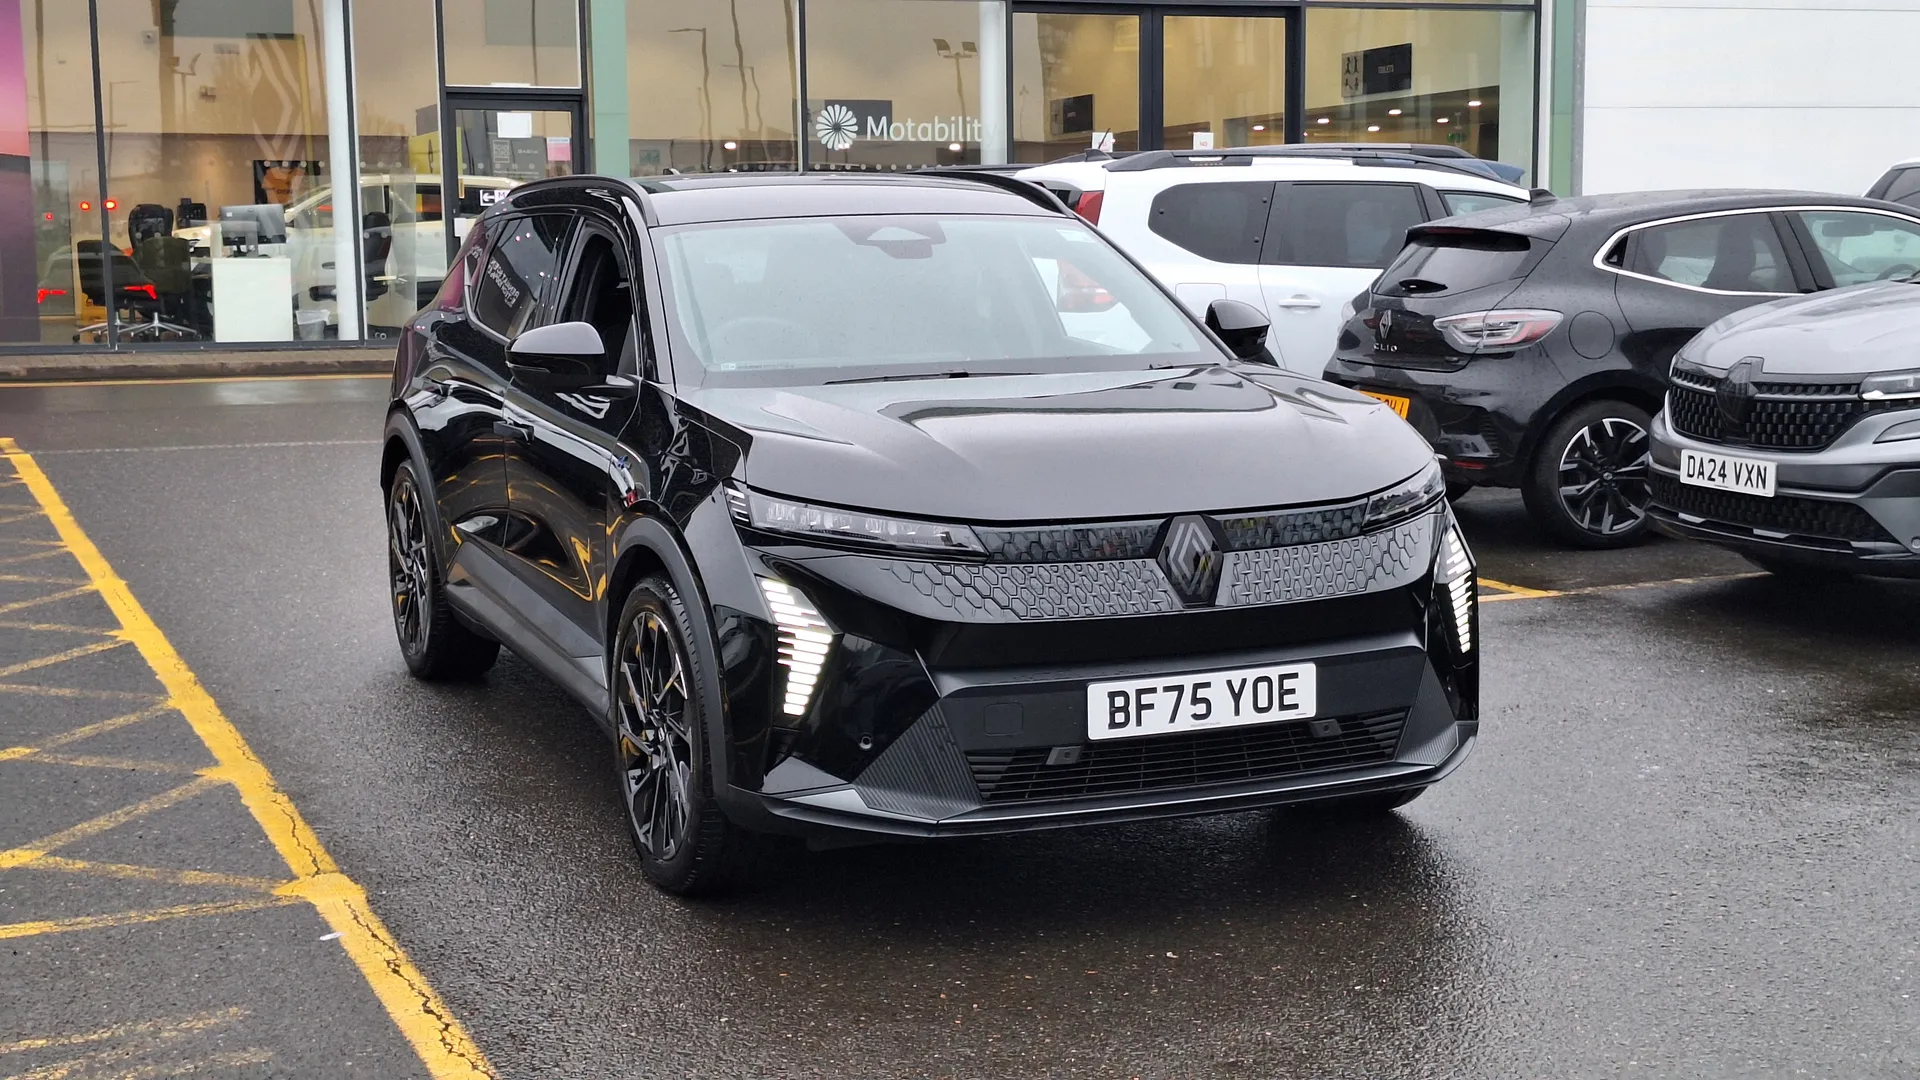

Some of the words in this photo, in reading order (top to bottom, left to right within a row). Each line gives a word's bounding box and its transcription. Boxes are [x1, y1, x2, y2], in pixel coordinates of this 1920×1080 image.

[1373, 342, 1398, 352] CLIO
[1687, 455, 1727, 483] DA24
[1733, 461, 1767, 489] VXN
[1107, 681, 1212, 730] BF75
[1225, 672, 1299, 717] YOE
